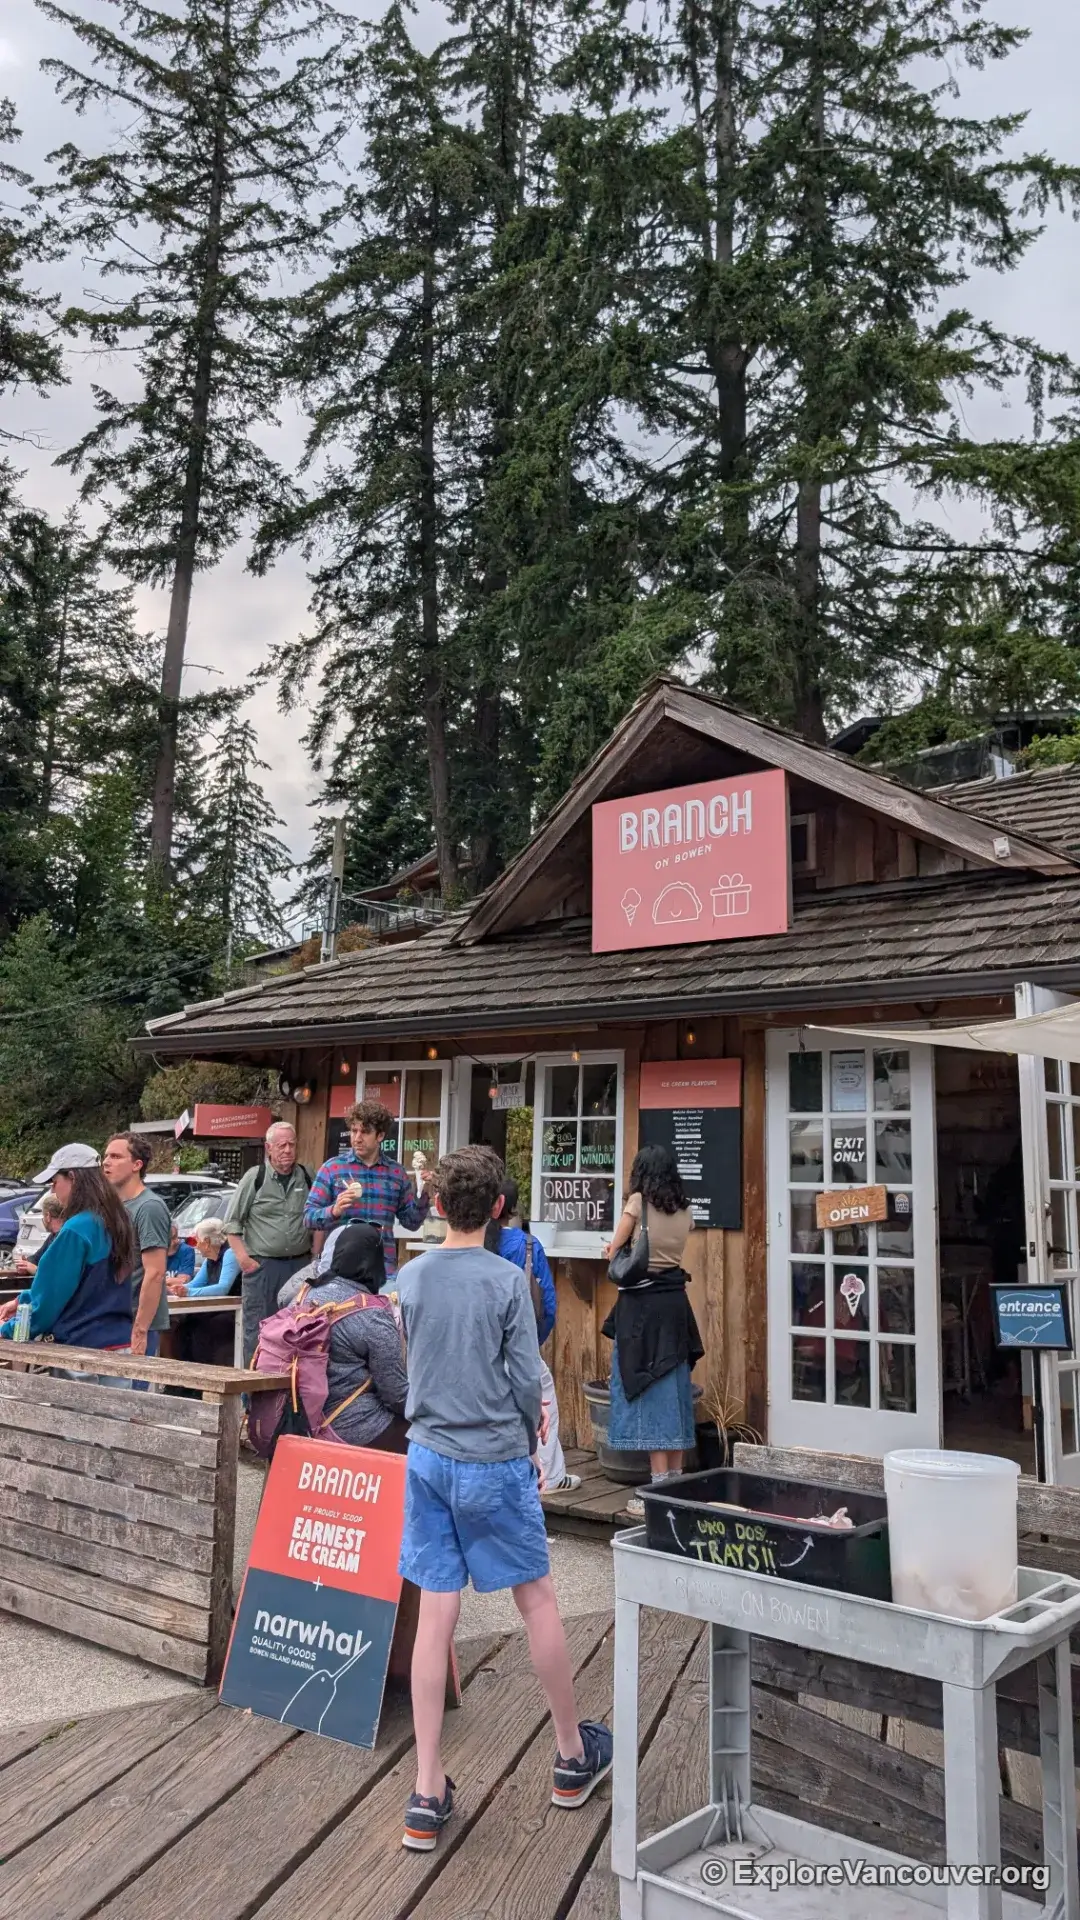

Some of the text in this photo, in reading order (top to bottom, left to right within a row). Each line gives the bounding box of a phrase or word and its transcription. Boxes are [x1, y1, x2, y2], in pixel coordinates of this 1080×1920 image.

[619, 790, 752, 854] BRANCH
[655, 844, 713, 870] ON BOWEN
[404, 1139, 435, 1151] INSIDE
[833, 1137, 864, 1149] EXIT
[542, 1152, 616, 1168] PICK-UP WINDOW
[833, 1151, 865, 1162] ONLY
[543, 1180, 591, 1199] ORDER
[543, 1200, 606, 1221] INSIDE
[829, 1204, 869, 1222] OPEN
[999, 1300, 1061, 1312] entrance
[298, 1461, 382, 1504] BRANCH
[302, 1504, 364, 1523] WE PROUDLY SCOOP
[291, 1516, 366, 1553] EARNEST
[288, 1539, 360, 1573] ICE CREAM
[689, 1540, 778, 1576] TRAYS!!
[741, 1591, 764, 1618] ON
[769, 1597, 830, 1634] BOWEN
[254, 1609, 363, 1656] narwhal
[249, 1646, 315, 1671] BOWEN ISLAND MARINA
[251, 1635, 317, 1661] QUALITY GOODS
